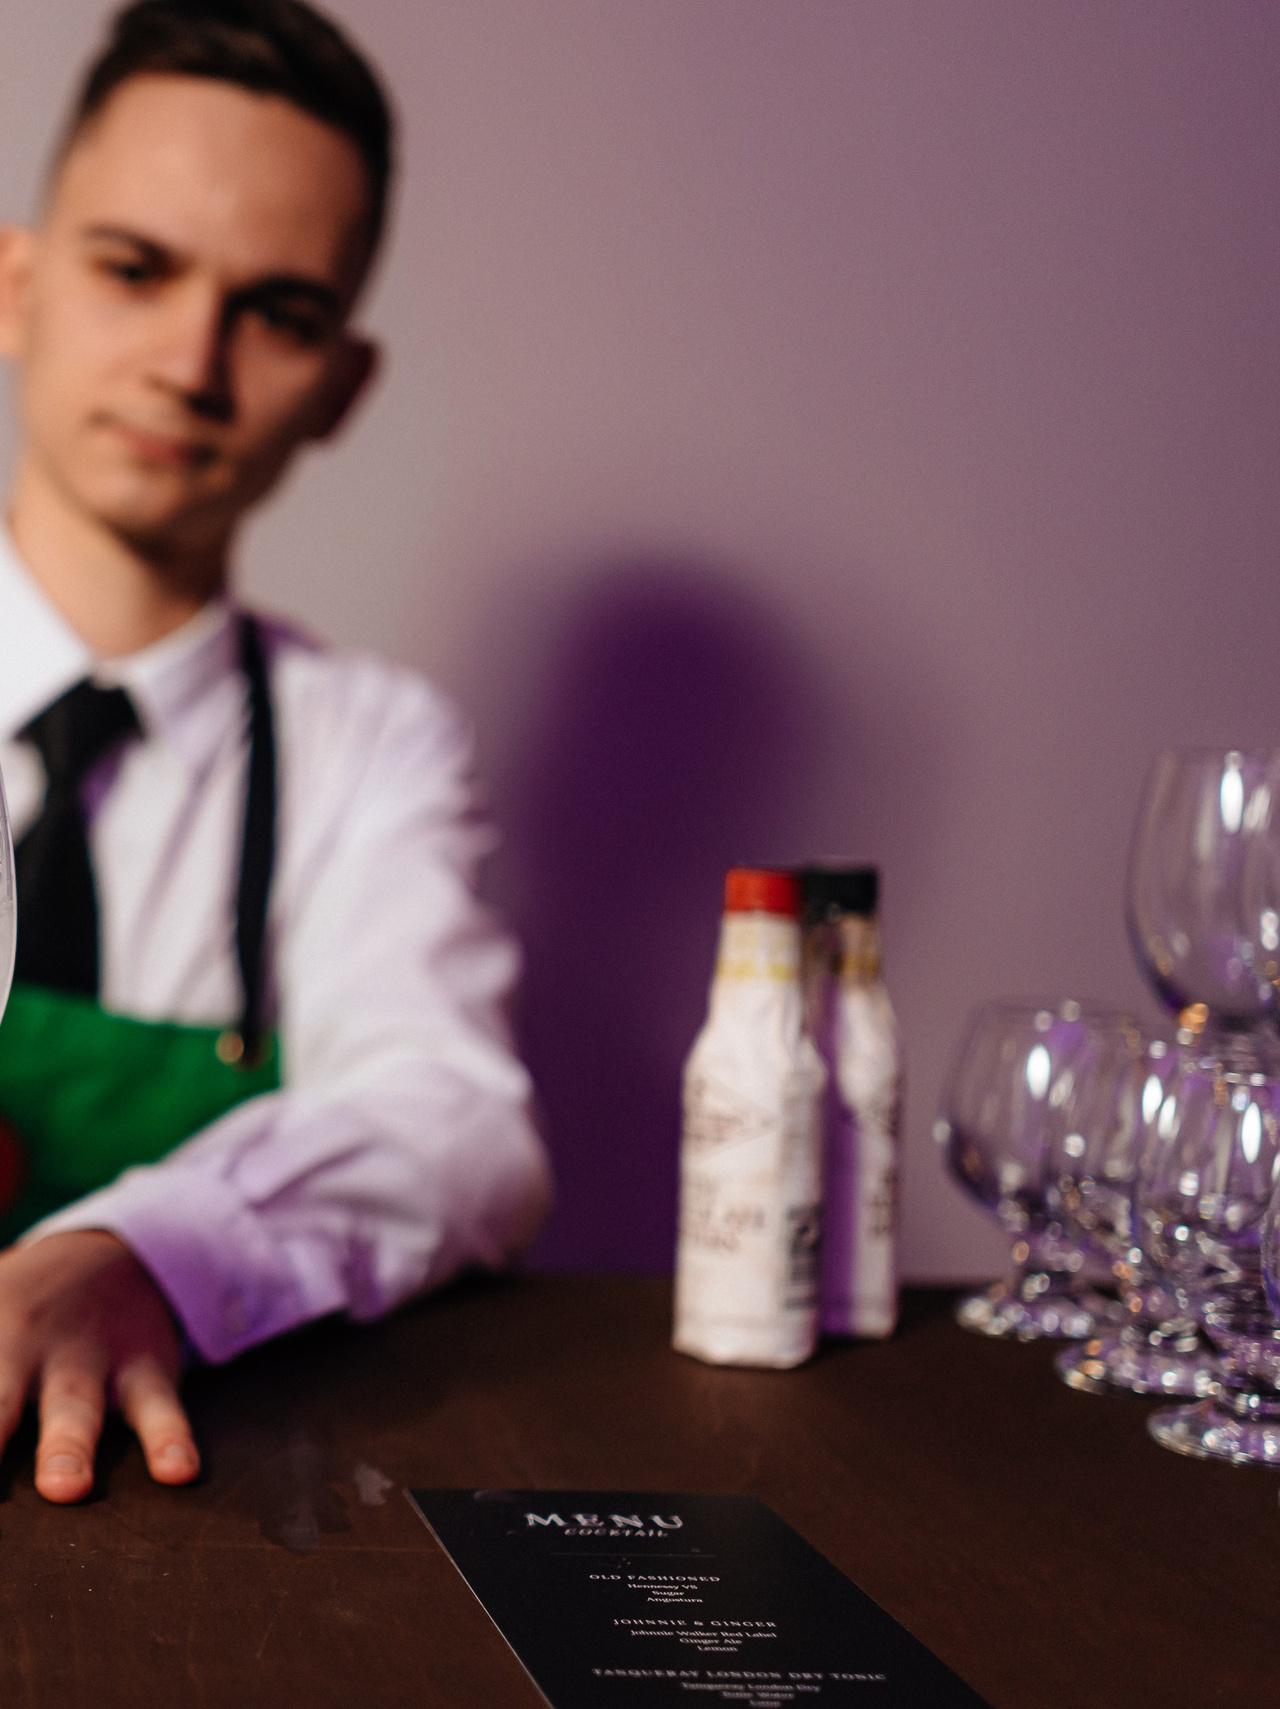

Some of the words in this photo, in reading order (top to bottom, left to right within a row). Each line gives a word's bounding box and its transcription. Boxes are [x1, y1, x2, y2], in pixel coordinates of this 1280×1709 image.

[525, 1513, 683, 1529] MENU
[564, 1529, 667, 1537] COCKTAIL
[711, 1620, 776, 1628] GINGER
[592, 1668, 698, 1678] TANQUERAY
[707, 1671, 781, 1679] LONDON
[789, 1672, 822, 1680] DRY
